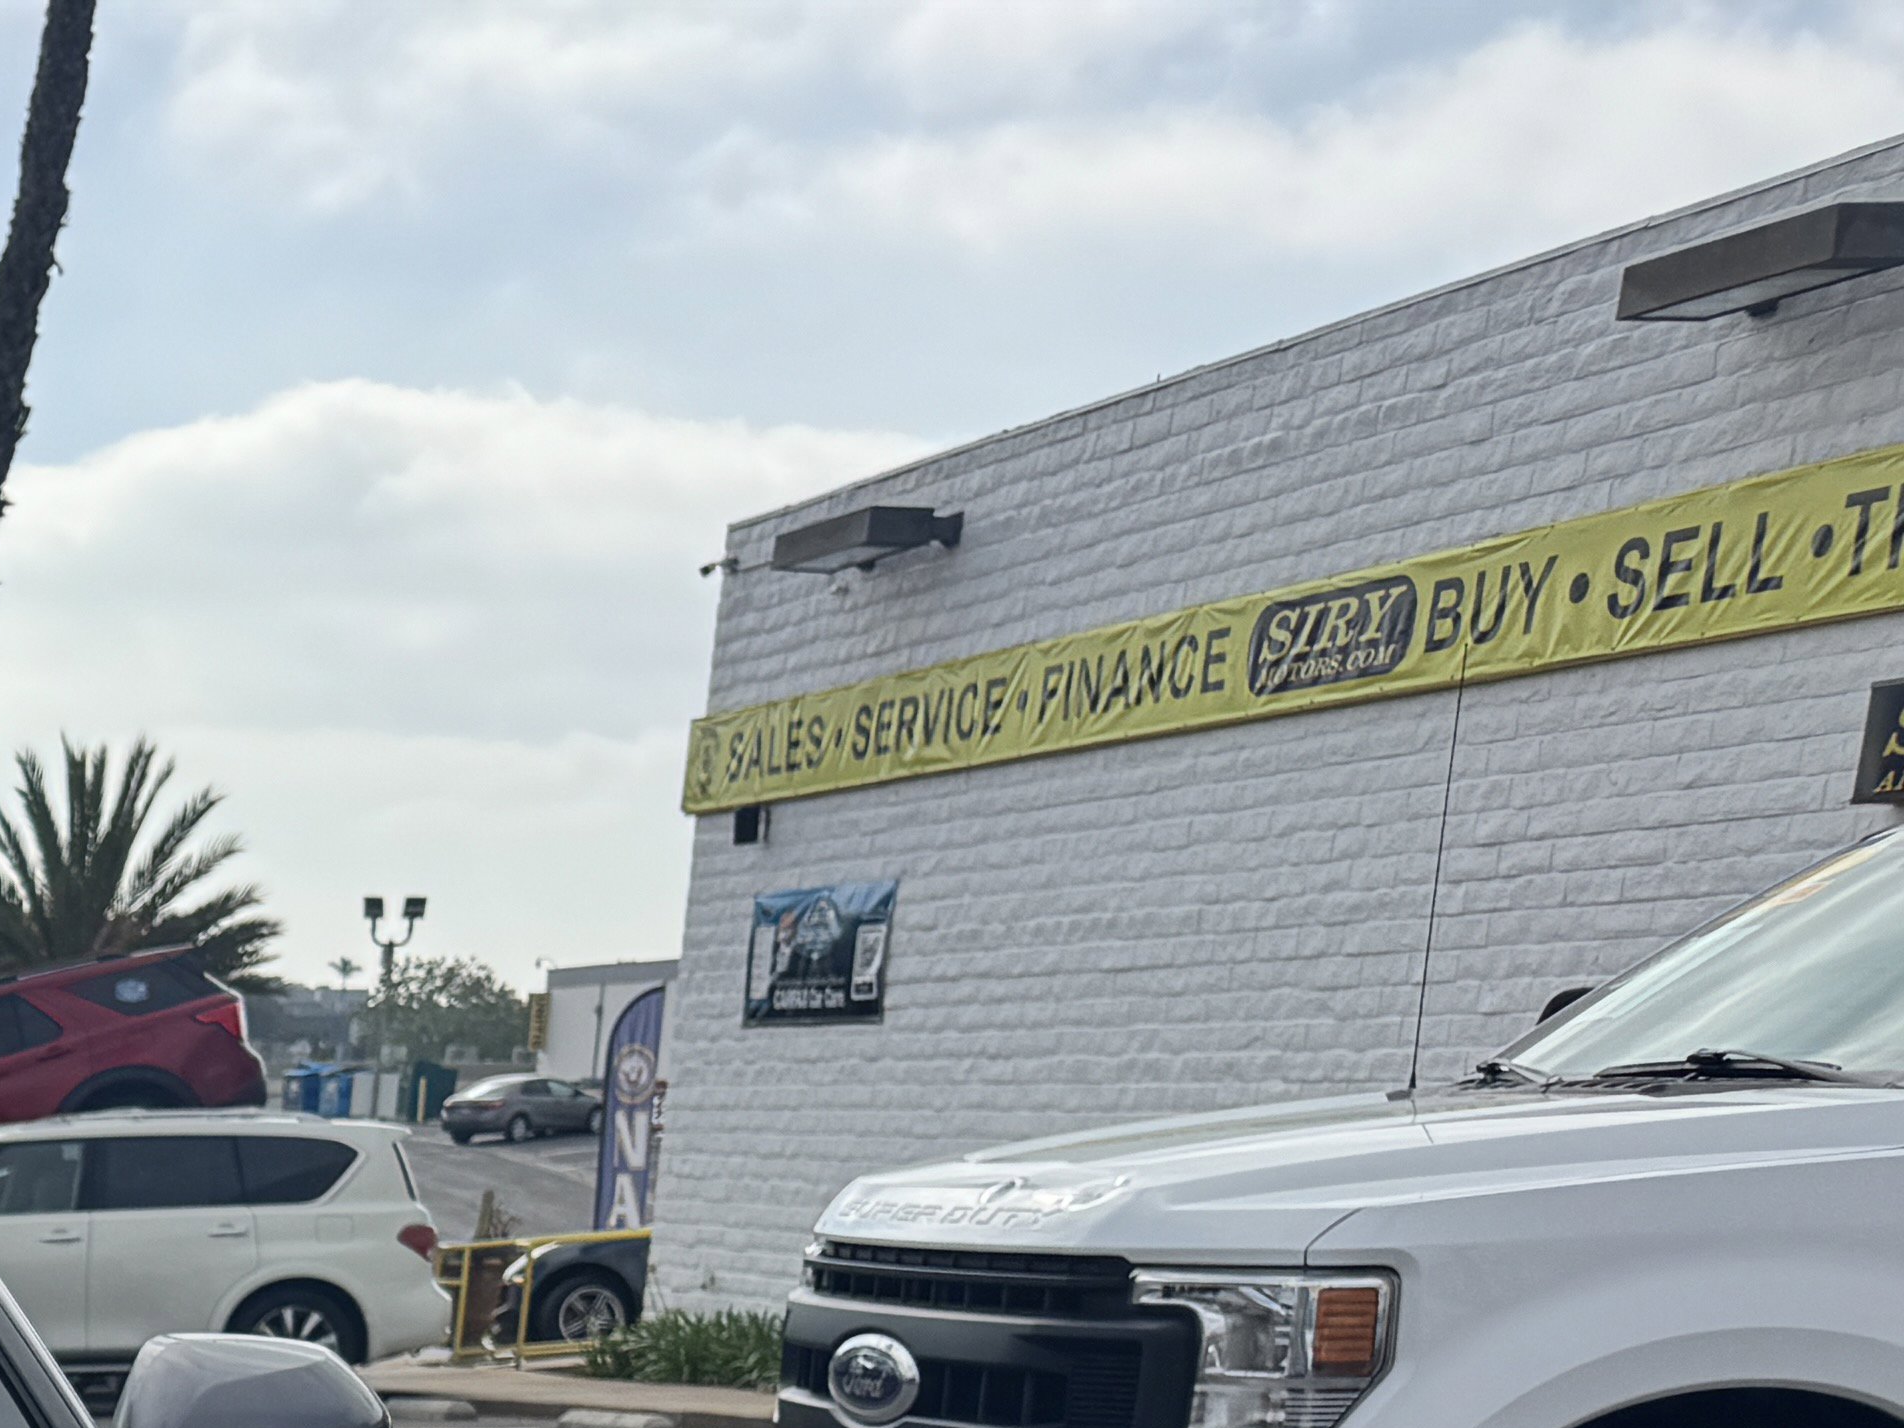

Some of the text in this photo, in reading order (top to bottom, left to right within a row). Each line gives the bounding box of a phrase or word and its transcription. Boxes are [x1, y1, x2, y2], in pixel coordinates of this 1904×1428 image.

[1258, 584, 1409, 664] SIRY
[1423, 486, 1904, 654] BUY SELL T
[726, 626, 1232, 784] SALES SERVICE FINANCE
[1254, 645, 1395, 691] MOTORS.COM
